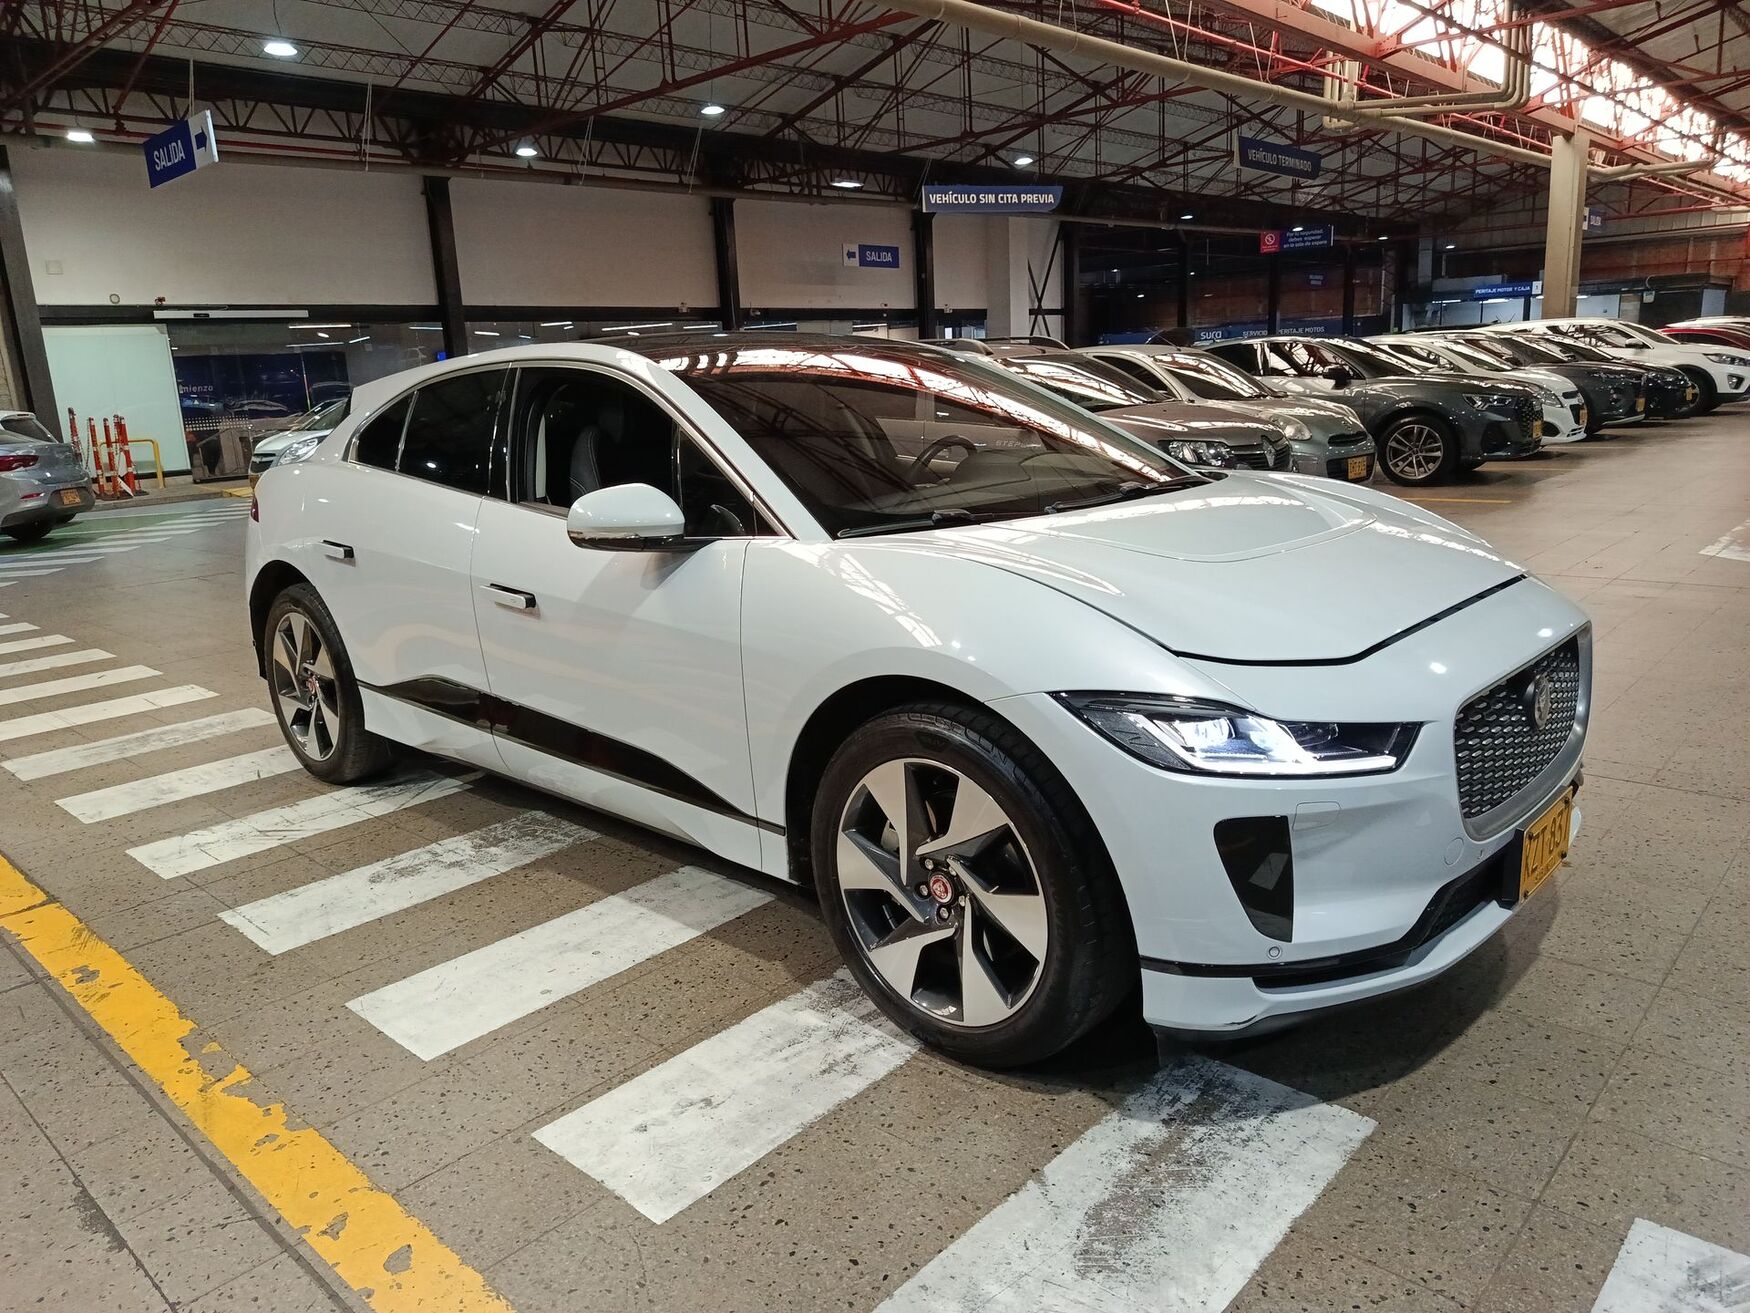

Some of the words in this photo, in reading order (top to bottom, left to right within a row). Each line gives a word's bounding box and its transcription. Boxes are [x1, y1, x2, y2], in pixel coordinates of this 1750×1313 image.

[153, 139, 186, 171] SALIDA
[1247, 148, 1277, 165] VEHÍCULO
[1278, 155, 1312, 172] TERMINADO
[929, 191, 977, 204] VEHÍCULO
[979, 194, 996, 204] SIN
[998, 194, 1018, 204] CITA
[1021, 194, 1054, 204] PREVIA
[866, 250, 892, 262] SALIDA
